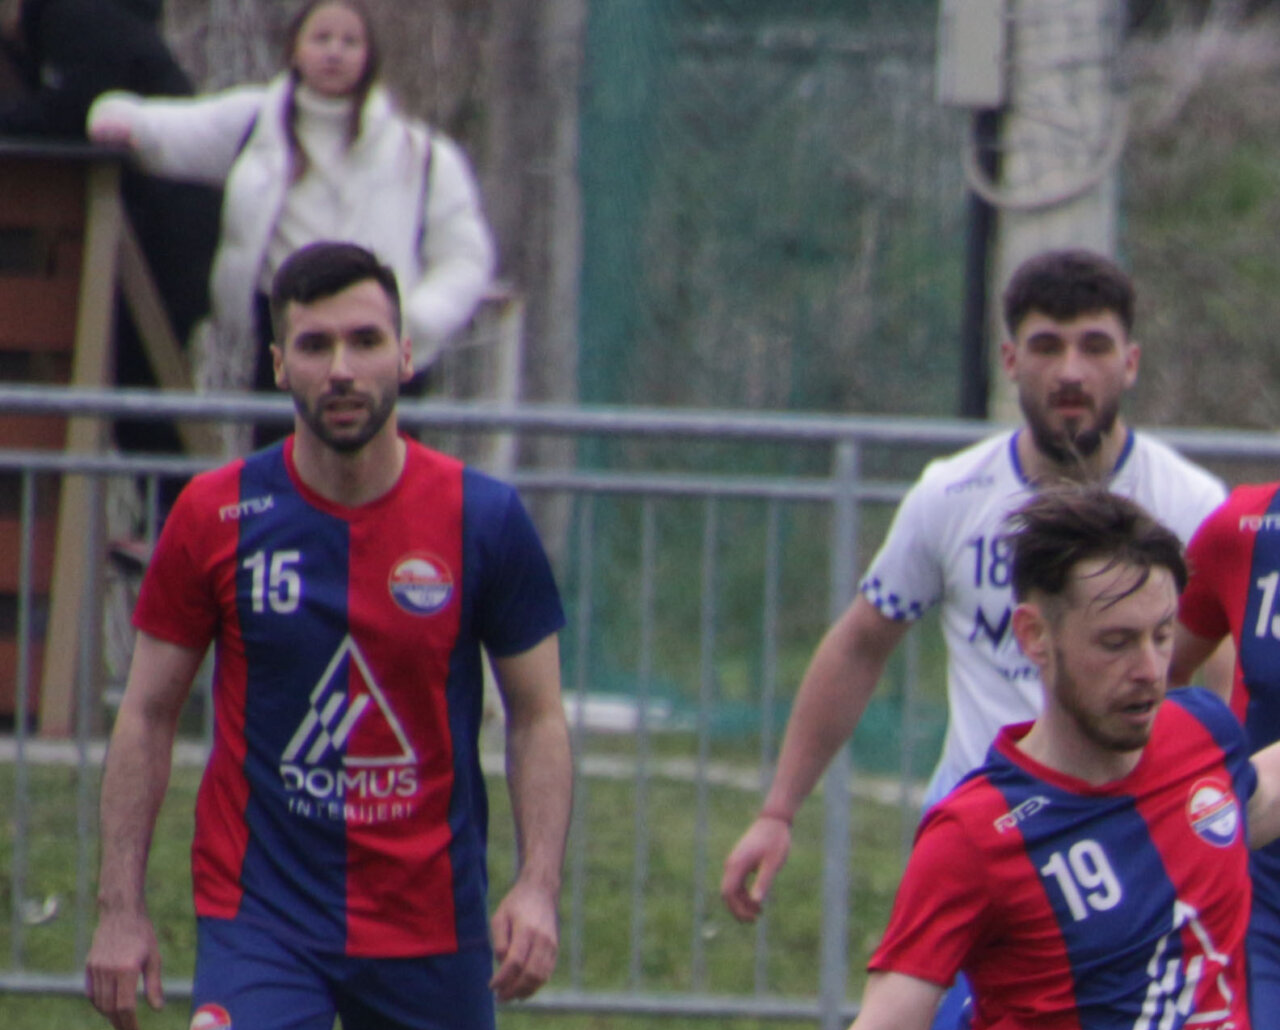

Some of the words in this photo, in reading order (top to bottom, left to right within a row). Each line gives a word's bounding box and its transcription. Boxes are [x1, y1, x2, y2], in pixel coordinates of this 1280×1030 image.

[242, 551, 299, 614] 15
[279, 765, 417, 798] DOMUS
[1041, 840, 1122, 921] 19
